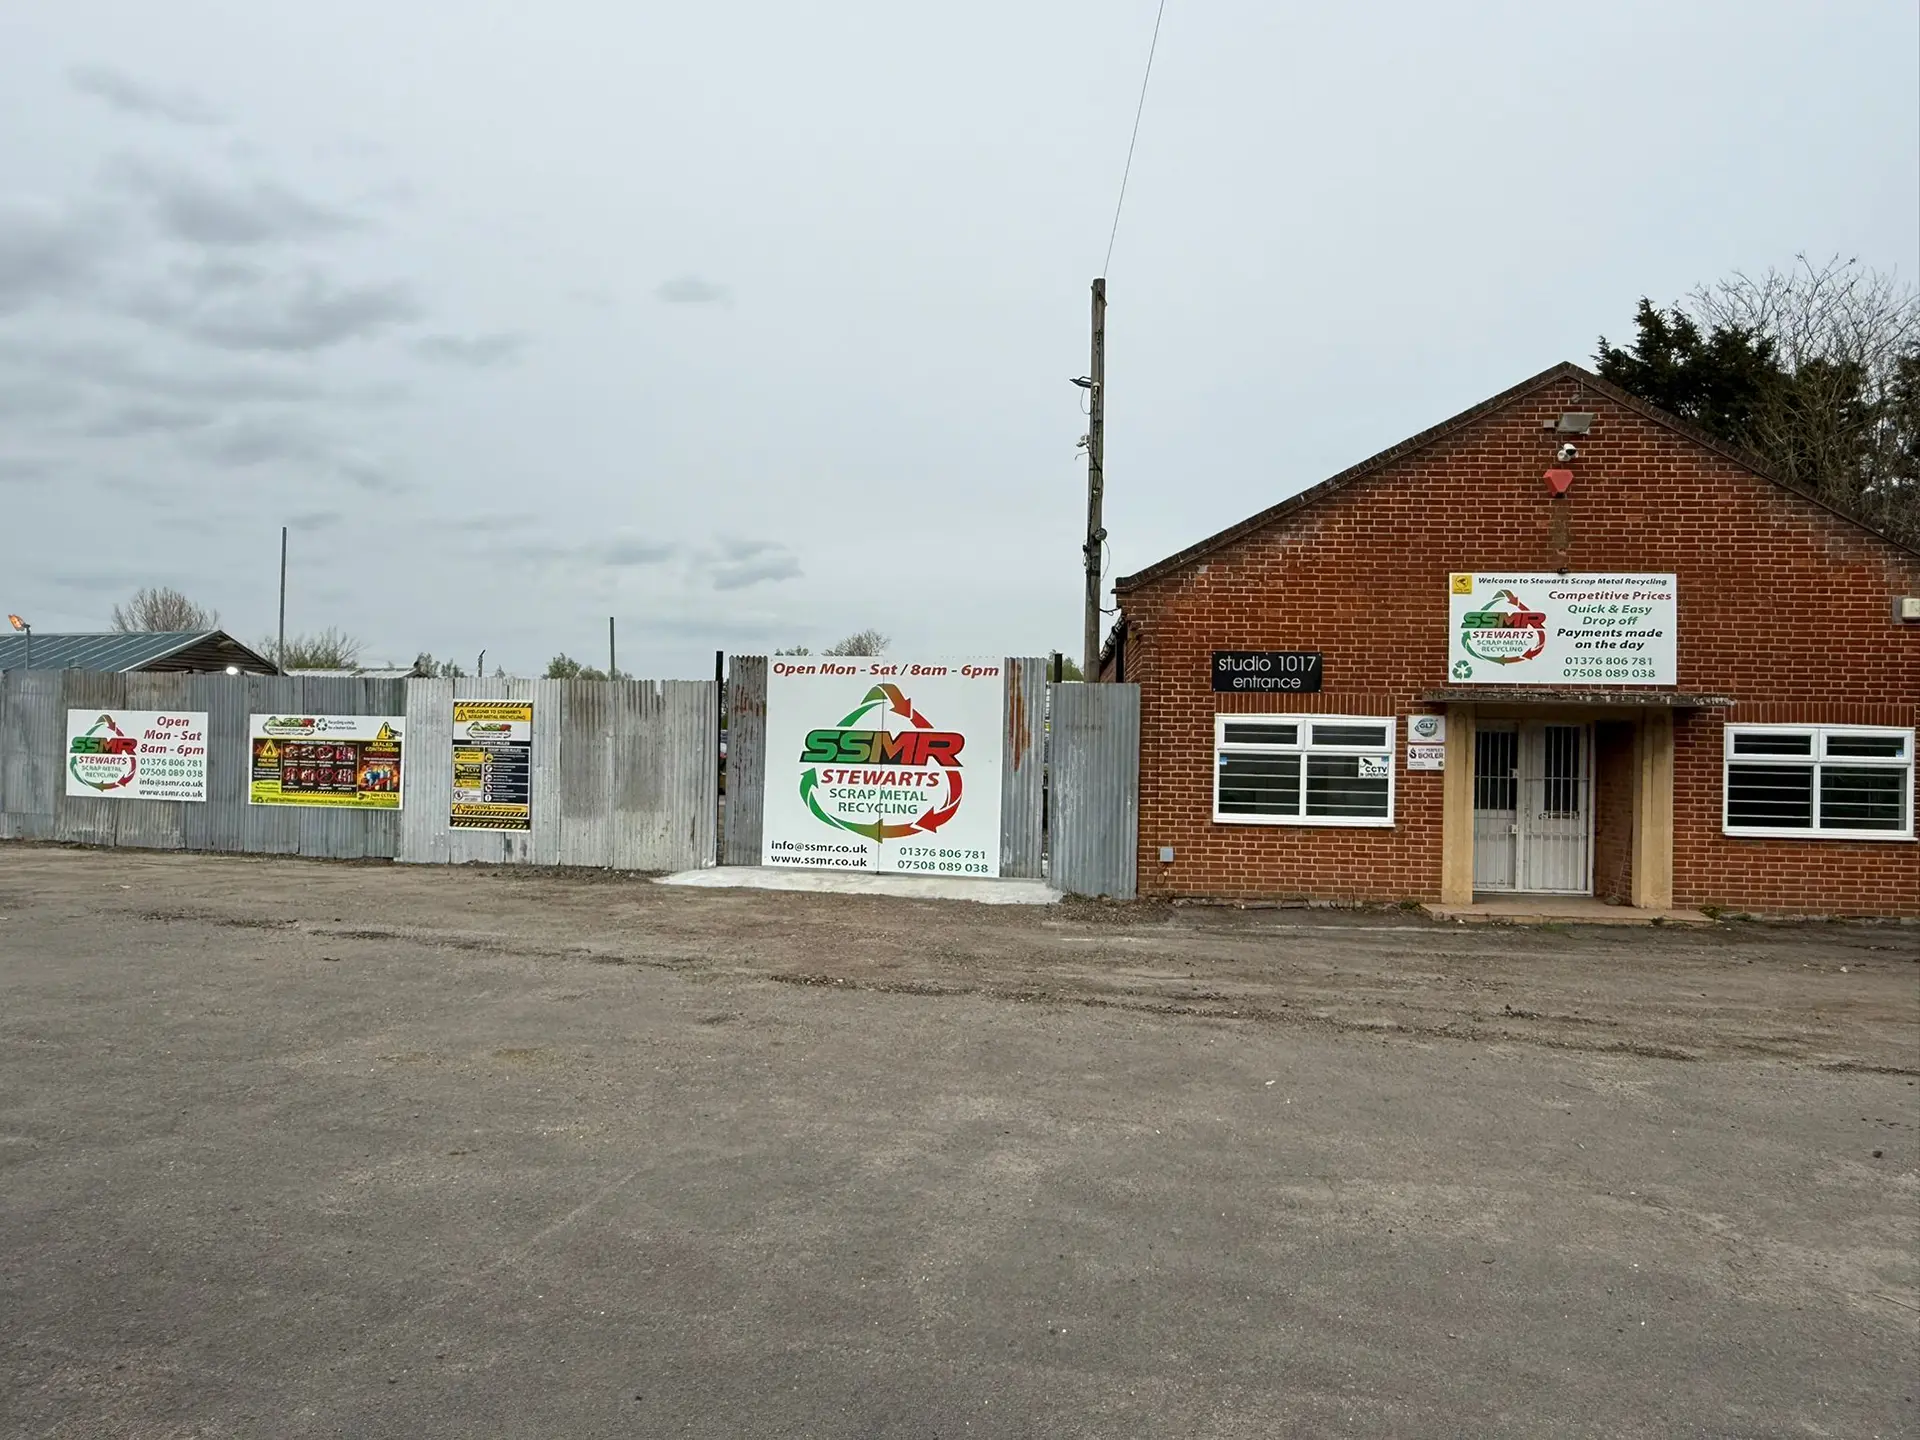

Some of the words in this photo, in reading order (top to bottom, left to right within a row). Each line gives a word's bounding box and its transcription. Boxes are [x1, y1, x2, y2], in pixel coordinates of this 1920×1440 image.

[1571, 578, 1595, 586] Scrap
[1625, 578, 1667, 586] Recycling
[1548, 591, 1629, 601] Competitive
[1632, 591, 1672, 600] Prices
[1568, 604, 1605, 614] Quick
[1608, 605, 1619, 613] &
[1622, 605, 1652, 615] Easy
[1460, 612, 1547, 629] SSMR
[1582, 616, 1616, 627] Drop
[1618, 616, 1638, 625] off
[1472, 631, 1534, 639] STEWARTS
[1557, 628, 1622, 639] Payments
[1625, 629, 1663, 637] made
[1575, 641, 1591, 649] on
[1595, 640, 1617, 649] the
[1620, 640, 1645, 651] day
[1218, 655, 1271, 671] studio
[1278, 655, 1316, 672] 1017
[1565, 657, 1603, 665] 01376
[1605, 657, 1628, 665] 806
[1631, 657, 1652, 665] 781
[773, 663, 816, 676] Open
[820, 663, 856, 675] Mon
[870, 664, 897, 675] Sat
[900, 664, 907, 677] /
[910, 664, 947, 676] 8am
[961, 666, 999, 678] 6pm
[1563, 669, 1602, 677] 07508
[1605, 669, 1629, 678] 089
[1632, 669, 1656, 678] 038
[1233, 675, 1301, 688] entrance
[157, 716, 189, 728] Open
[143, 730, 170, 740] Mon
[180, 731, 202, 741] Sat
[69, 736, 138, 755] SSMR
[140, 744, 167, 753] 8am
[177, 745, 204, 757] 6pm
[799, 729, 965, 767] SSMR
[78, 756, 127, 765] STEWARTS
[140, 758, 167, 766] 01376
[168, 759, 185, 767] 806
[187, 759, 202, 767] 781
[168, 769, 185, 777] 089
[821, 769, 940, 787] STEWARTS
[139, 779, 203, 788] info@ssmr.co.uk
[139, 789, 203, 798] www.ssmr.co.uk
[829, 788, 877, 799] SCRAP
[880, 789, 928, 801] METAL
[838, 803, 918, 814] RECYCLING
[771, 840, 867, 853] info@ssmr.co.uk
[900, 847, 936, 857] 01376
[939, 849, 961, 858] 806
[964, 850, 985, 859] 781
[771, 855, 867, 867] www.ssmr.co.uk
[897, 860, 935, 870] 07508
[939, 862, 961, 871] 089
[965, 864, 988, 873] 038
